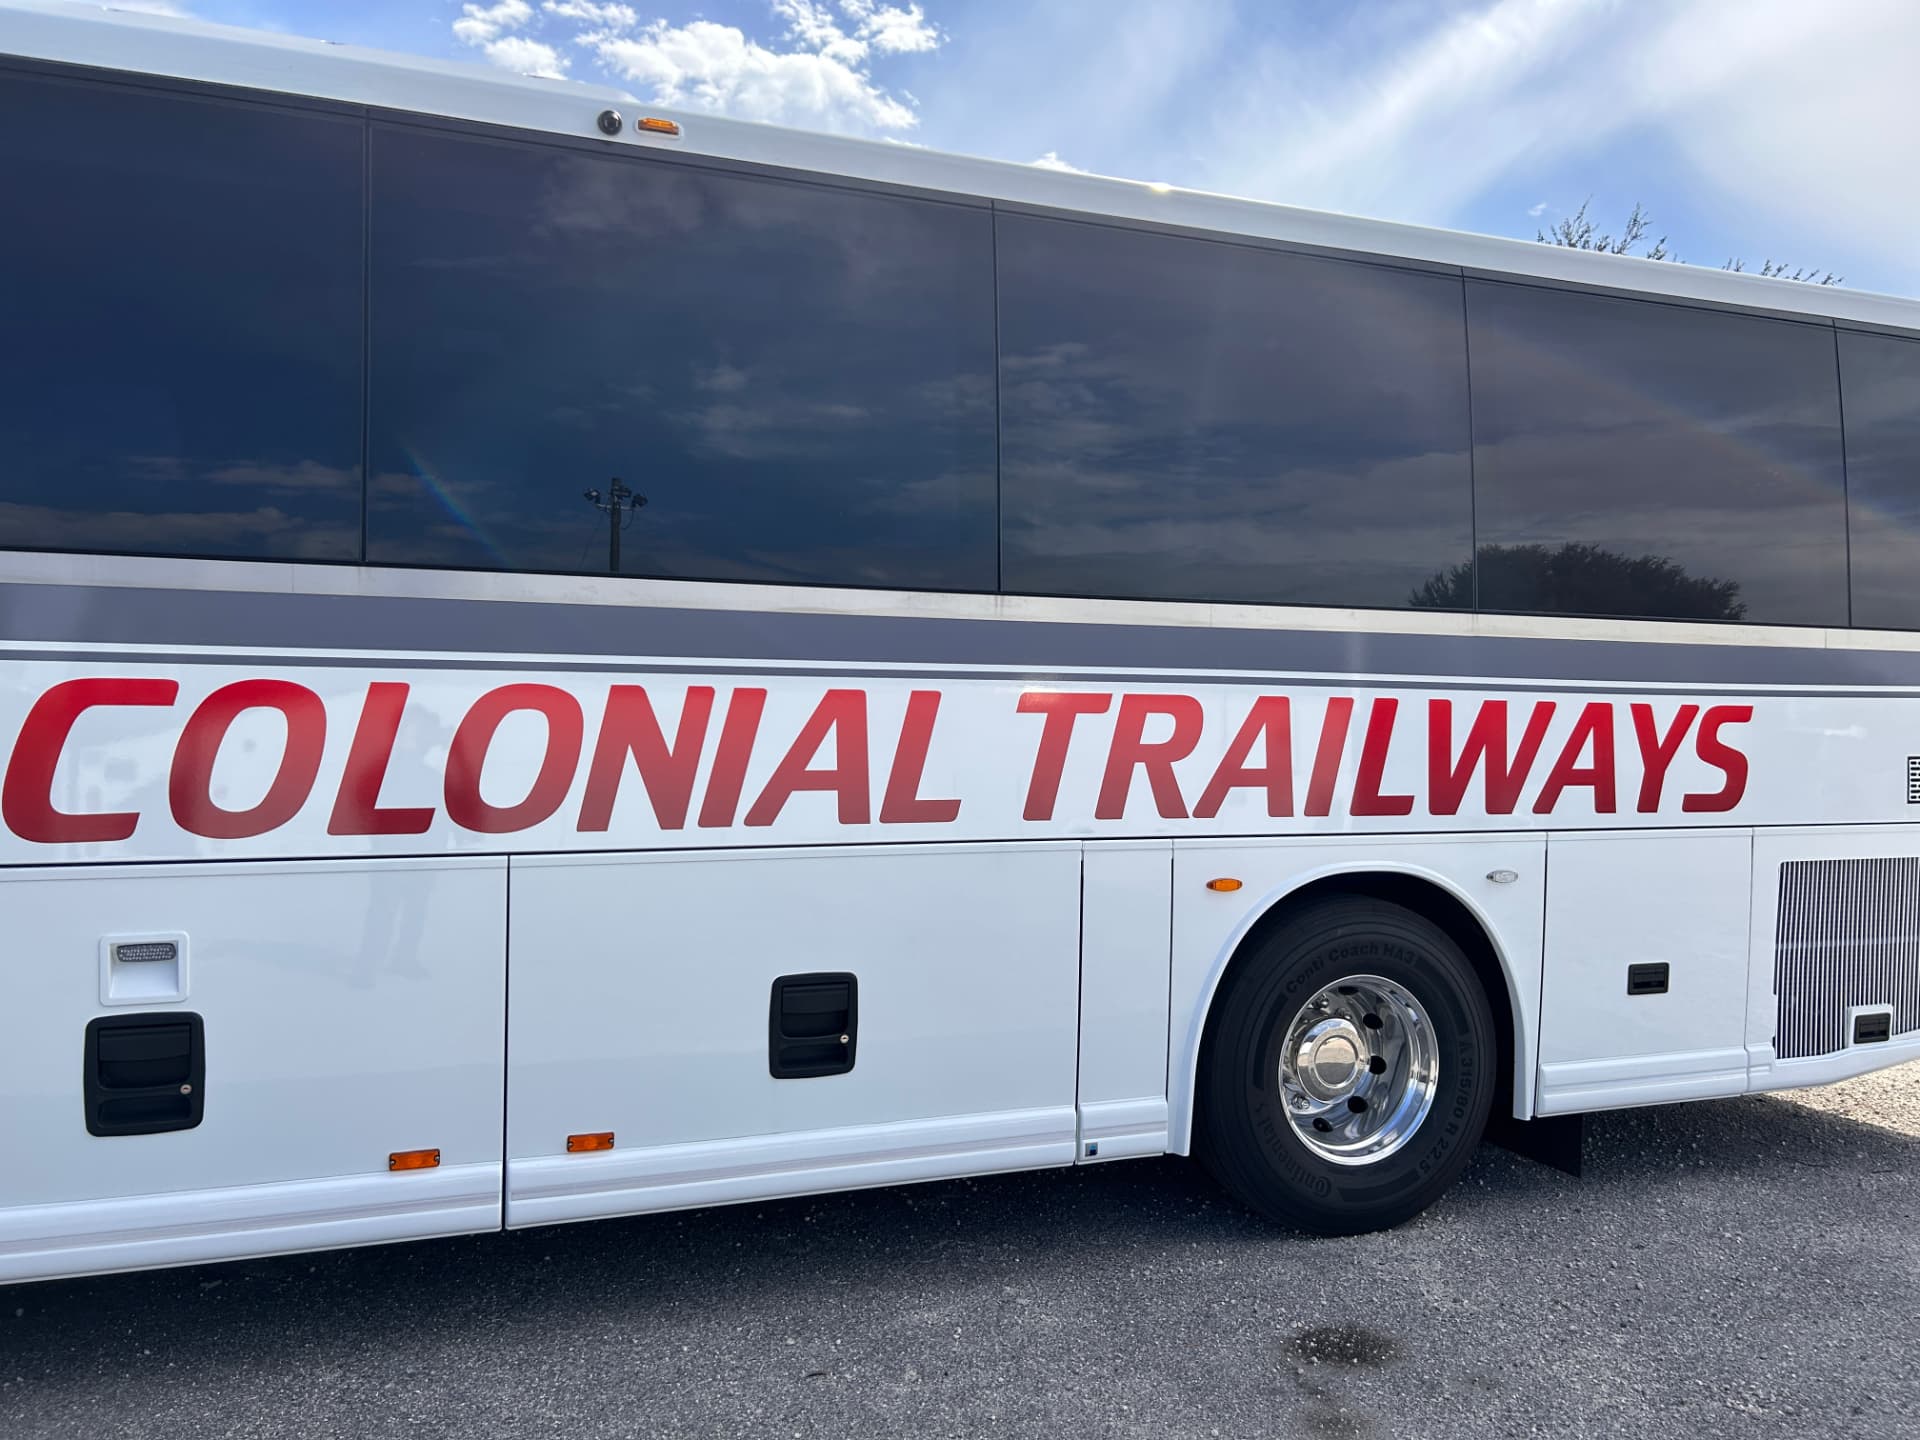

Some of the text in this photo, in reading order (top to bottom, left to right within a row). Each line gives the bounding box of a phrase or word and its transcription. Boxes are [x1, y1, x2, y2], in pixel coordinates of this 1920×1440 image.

[3, 677, 1753, 843] COLONIAL TRAILWAYS
[1286, 941, 1417, 994] Conti Coach HA3
[1453, 1057, 1473, 1120] 315/80
[1418, 1136, 1449, 1174] 22.5
[1445, 1122, 1459, 1137] R
